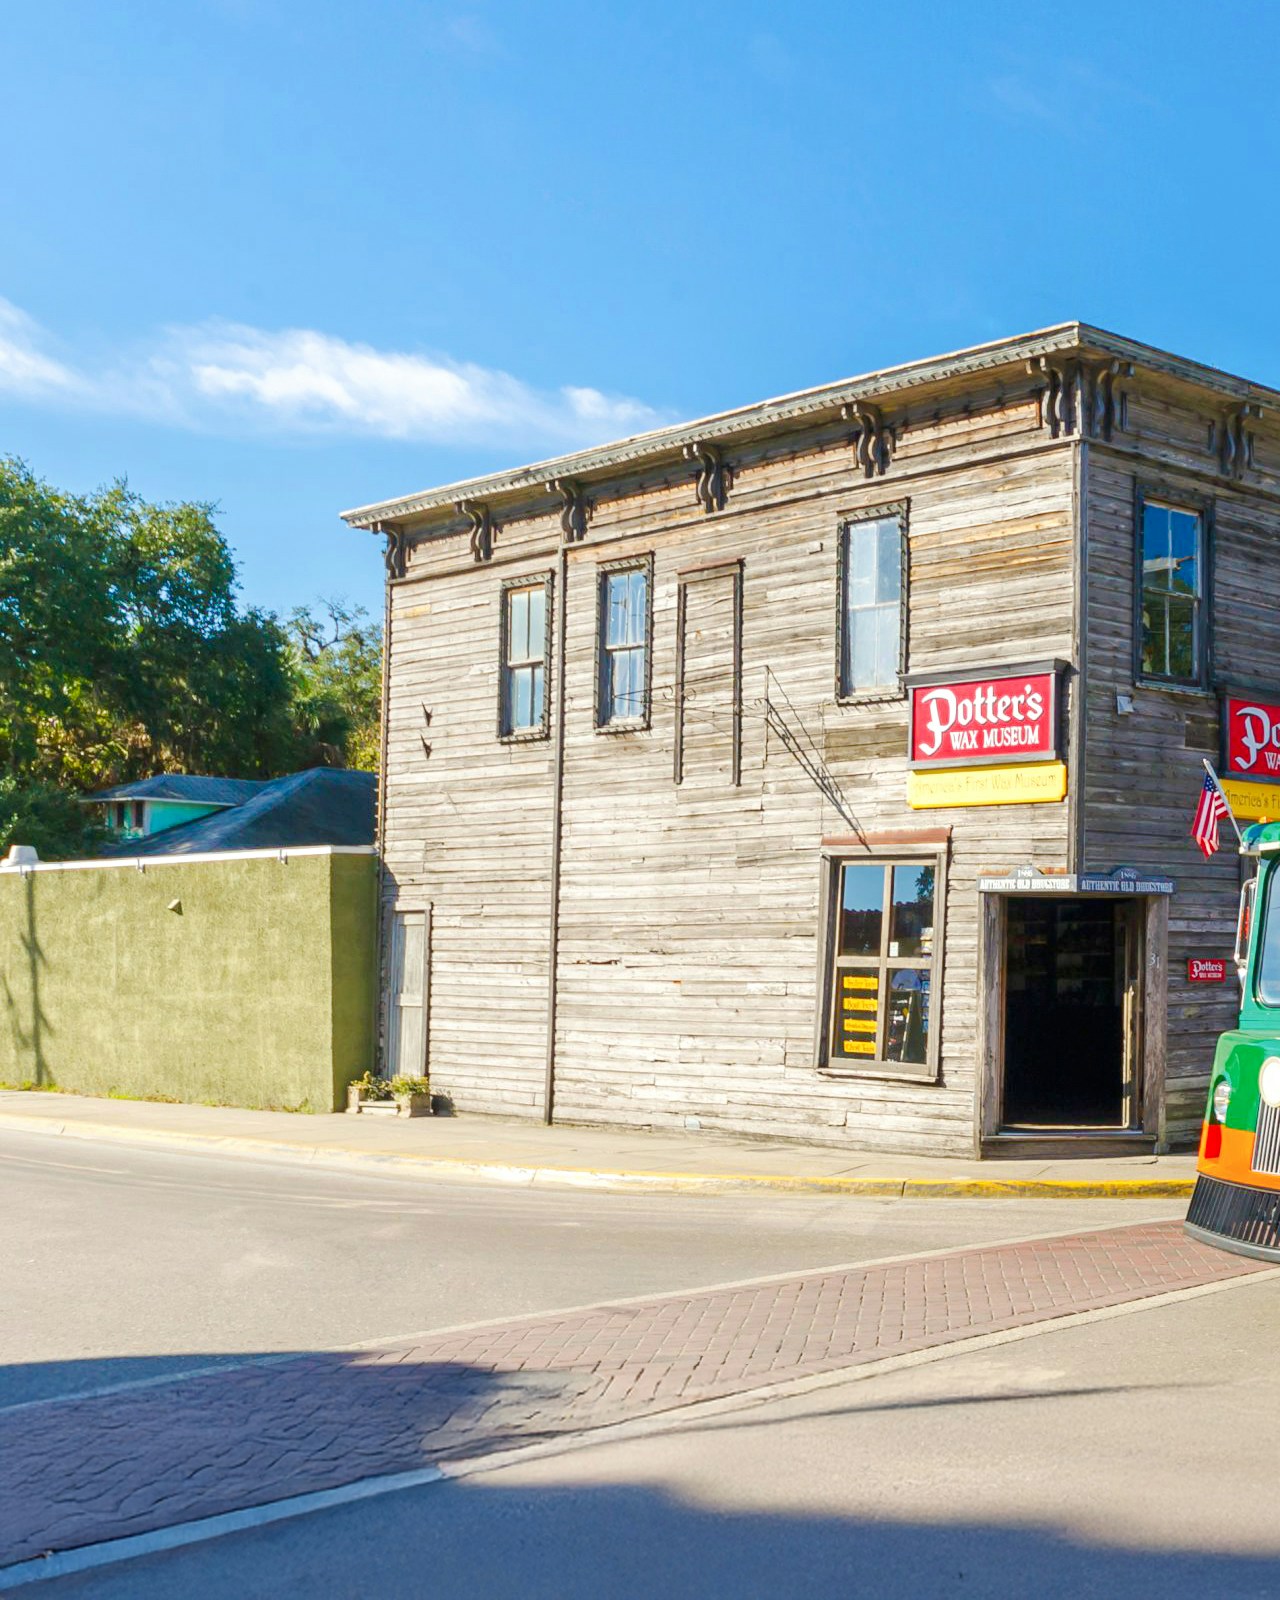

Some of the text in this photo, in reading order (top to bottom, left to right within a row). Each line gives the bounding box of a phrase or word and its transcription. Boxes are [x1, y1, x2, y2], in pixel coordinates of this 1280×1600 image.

[919, 684, 1044, 756] Potter's
[950, 725, 1040, 750] WAX MUSEUM
[966, 775, 988, 791] First
[992, 774, 1011, 790] Wax
[1015, 773, 1056, 789] Museum
[1225, 788, 1269, 808] America's
[980, 878, 1070, 890] AUTHENTIC OLD DRUGSTORE
[1081, 879, 1174, 893] AUTHENTIC OLD DRUGSTORE
[1192, 960, 1223, 978] Potter's
